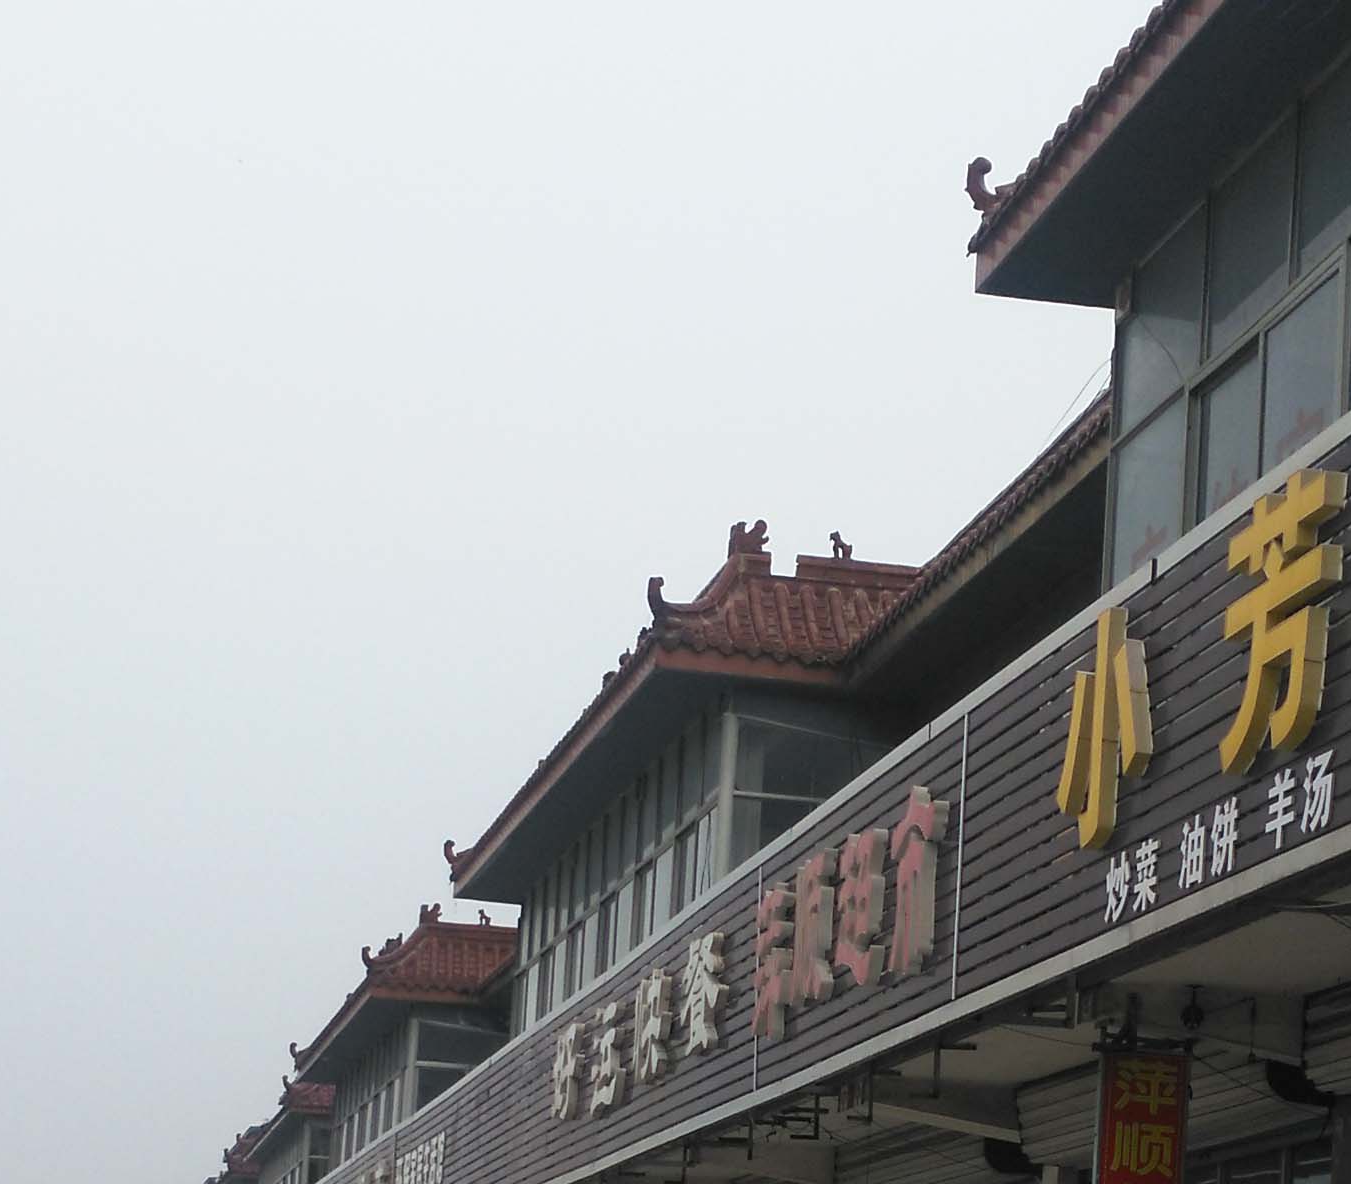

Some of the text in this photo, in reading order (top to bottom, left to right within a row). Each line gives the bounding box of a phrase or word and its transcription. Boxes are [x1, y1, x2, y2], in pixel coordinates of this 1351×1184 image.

[1104, 838, 1162, 924] 炒菜
[1178, 796, 1241, 891] 油饼
[1263, 748, 1337, 850] 羊汤
